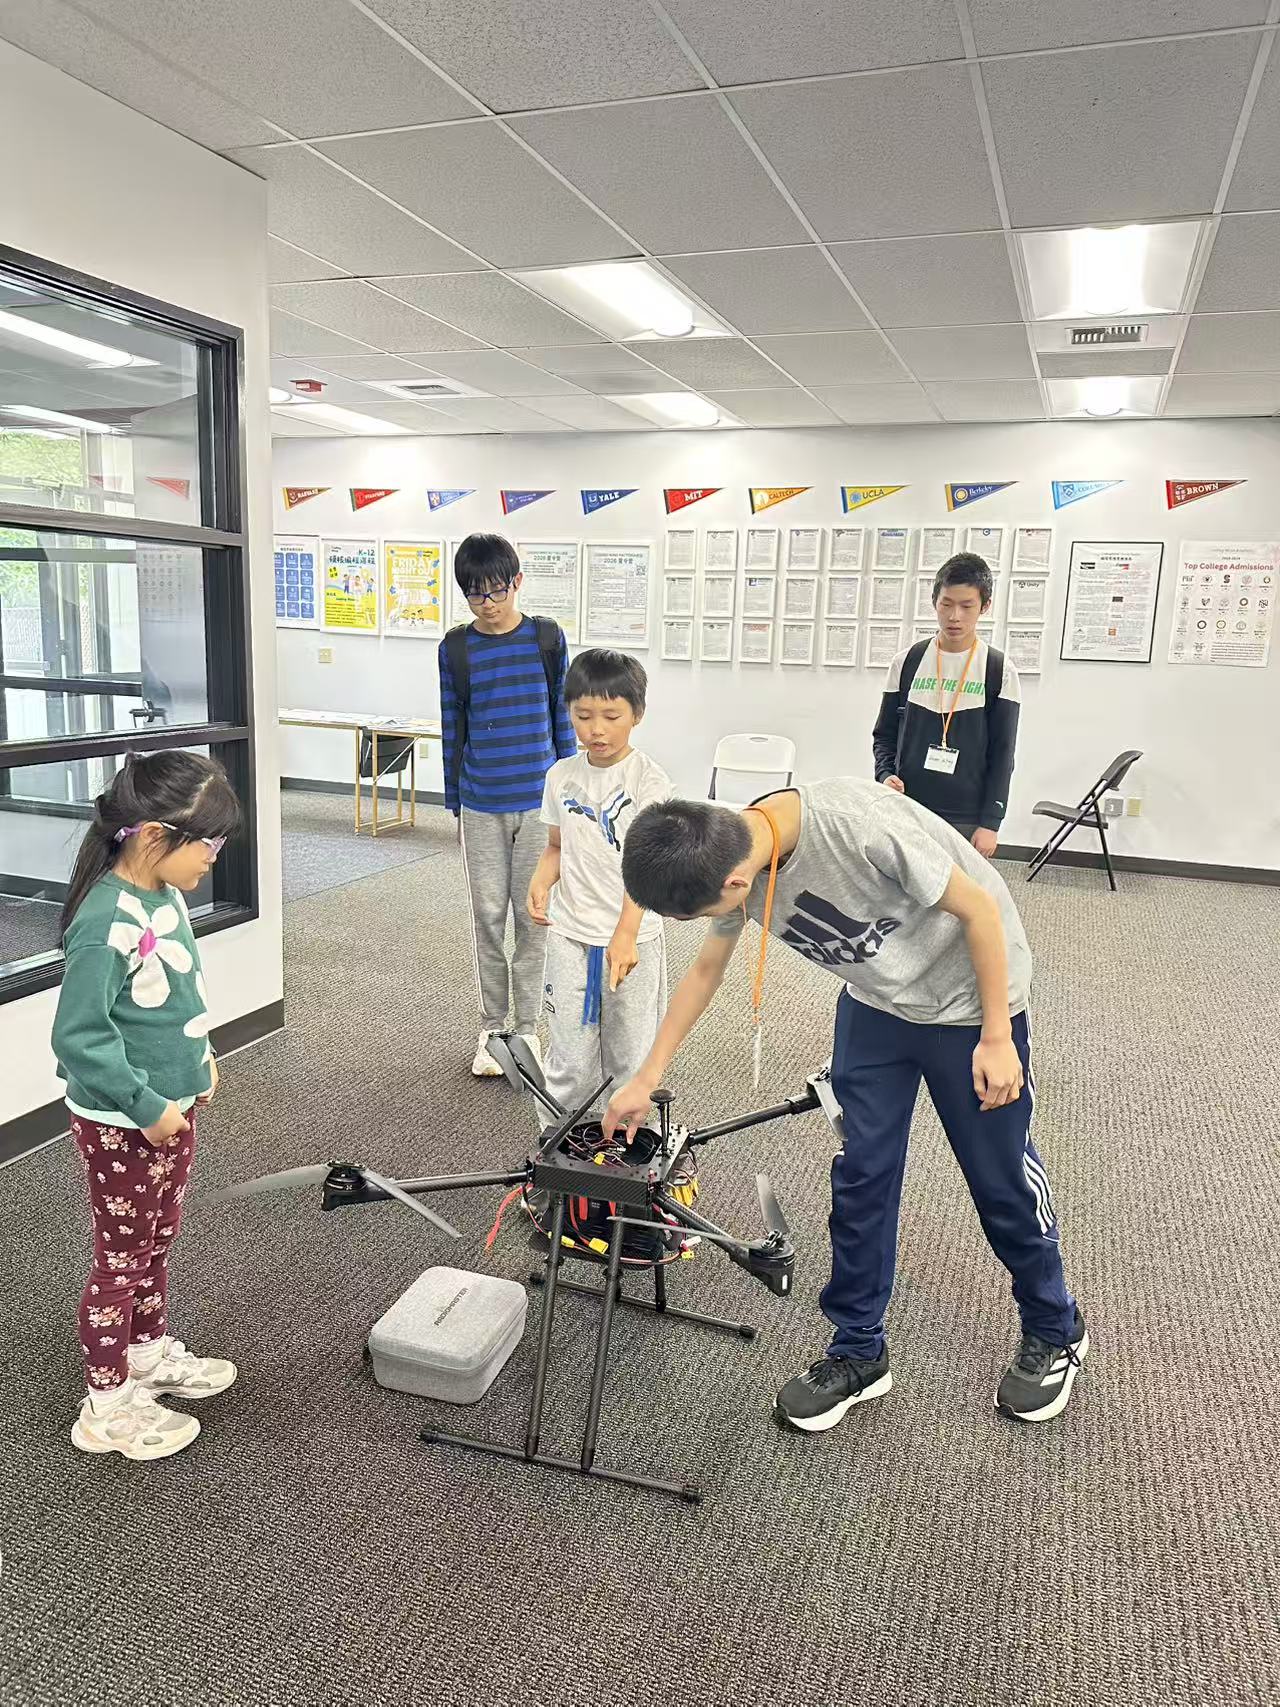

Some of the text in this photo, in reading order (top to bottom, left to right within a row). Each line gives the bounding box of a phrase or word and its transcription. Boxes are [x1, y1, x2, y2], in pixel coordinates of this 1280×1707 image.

[768, 488, 795, 500] CALTECH
[862, 488, 885, 500] UCLA
[968, 484, 993, 496] Berkeley
[1186, 482, 1219, 495] BROWN
[599, 491, 620, 502] YALE
[684, 490, 703, 502] MIT
[358, 548, 375, 557] K-12
[1184, 562, 1274, 571] Top College Admissions
[912, 678, 938, 690] HASE
[788, 917, 903, 966] adidas
